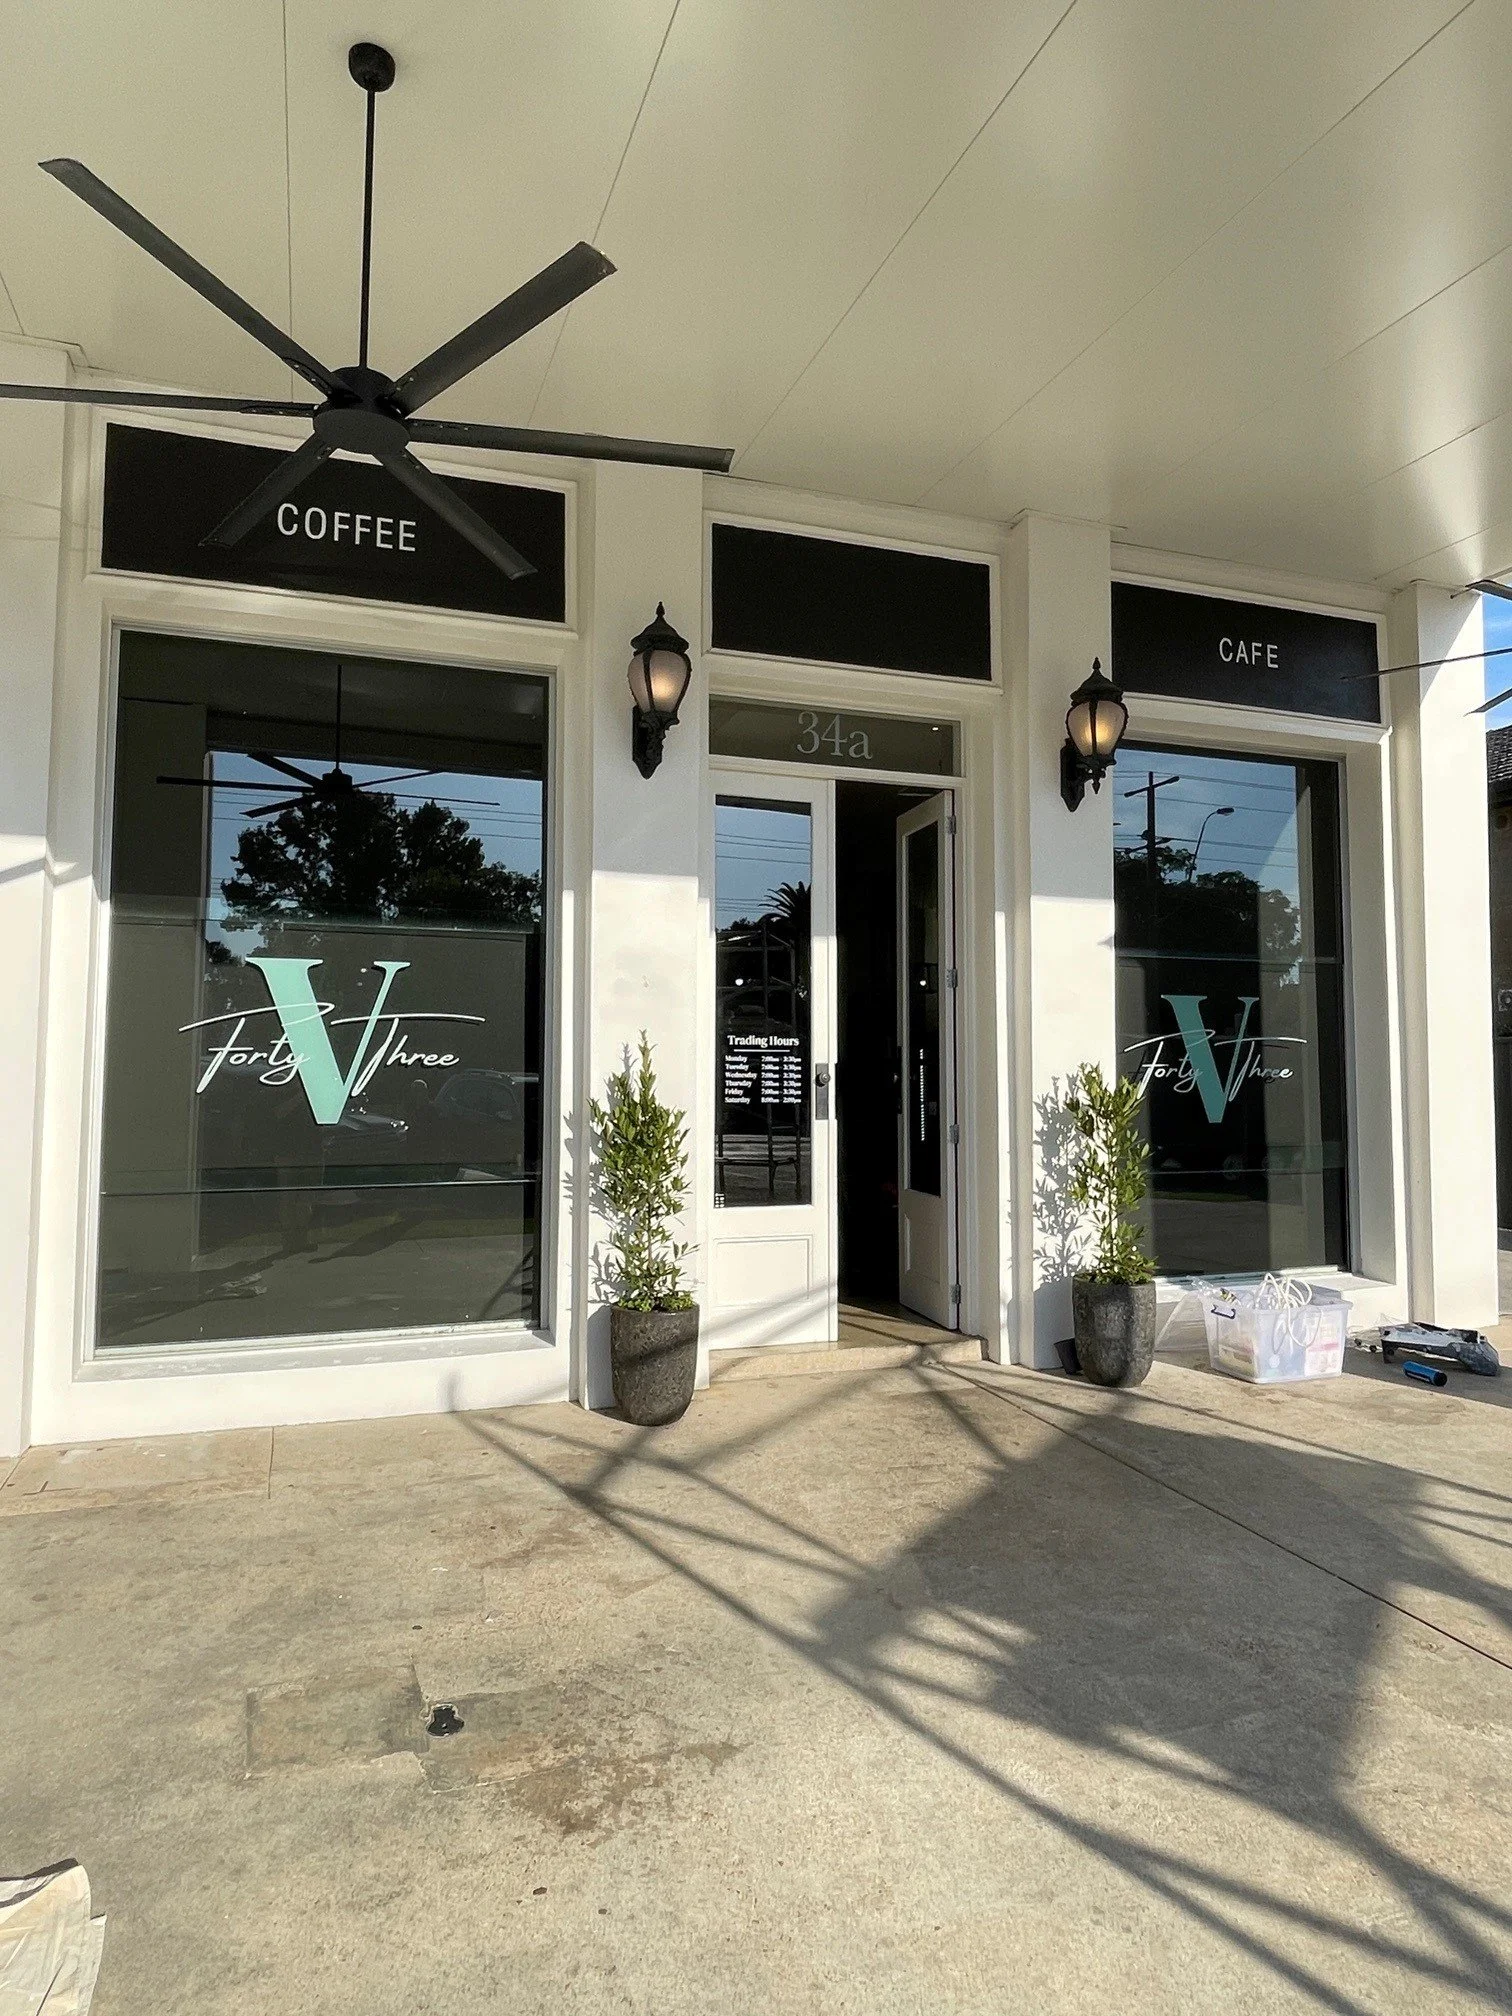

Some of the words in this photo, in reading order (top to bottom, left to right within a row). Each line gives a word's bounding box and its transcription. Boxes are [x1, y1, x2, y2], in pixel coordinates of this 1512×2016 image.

[277, 503, 416, 552] COFFEE
[1219, 637, 1279, 668] CAFE
[797, 711, 873, 760] 34a
[727, 1035, 768, 1048] Trading
[769, 1035, 800, 1046] Hours
[179, 1002, 335, 1094] Forty
[331, 1013, 486, 1097] Three
[724, 1055, 748, 1063] Monday
[724, 1063, 749, 1071] Tuesday
[1124, 1029, 1216, 1100] Forty
[1214, 1036, 1307, 1102] Three
[724, 1072, 758, 1080] Wednesday
[724, 1080, 752, 1088] Thursday
[724, 1088, 744, 1096] Friday
[724, 1097, 751, 1105] Saturday
